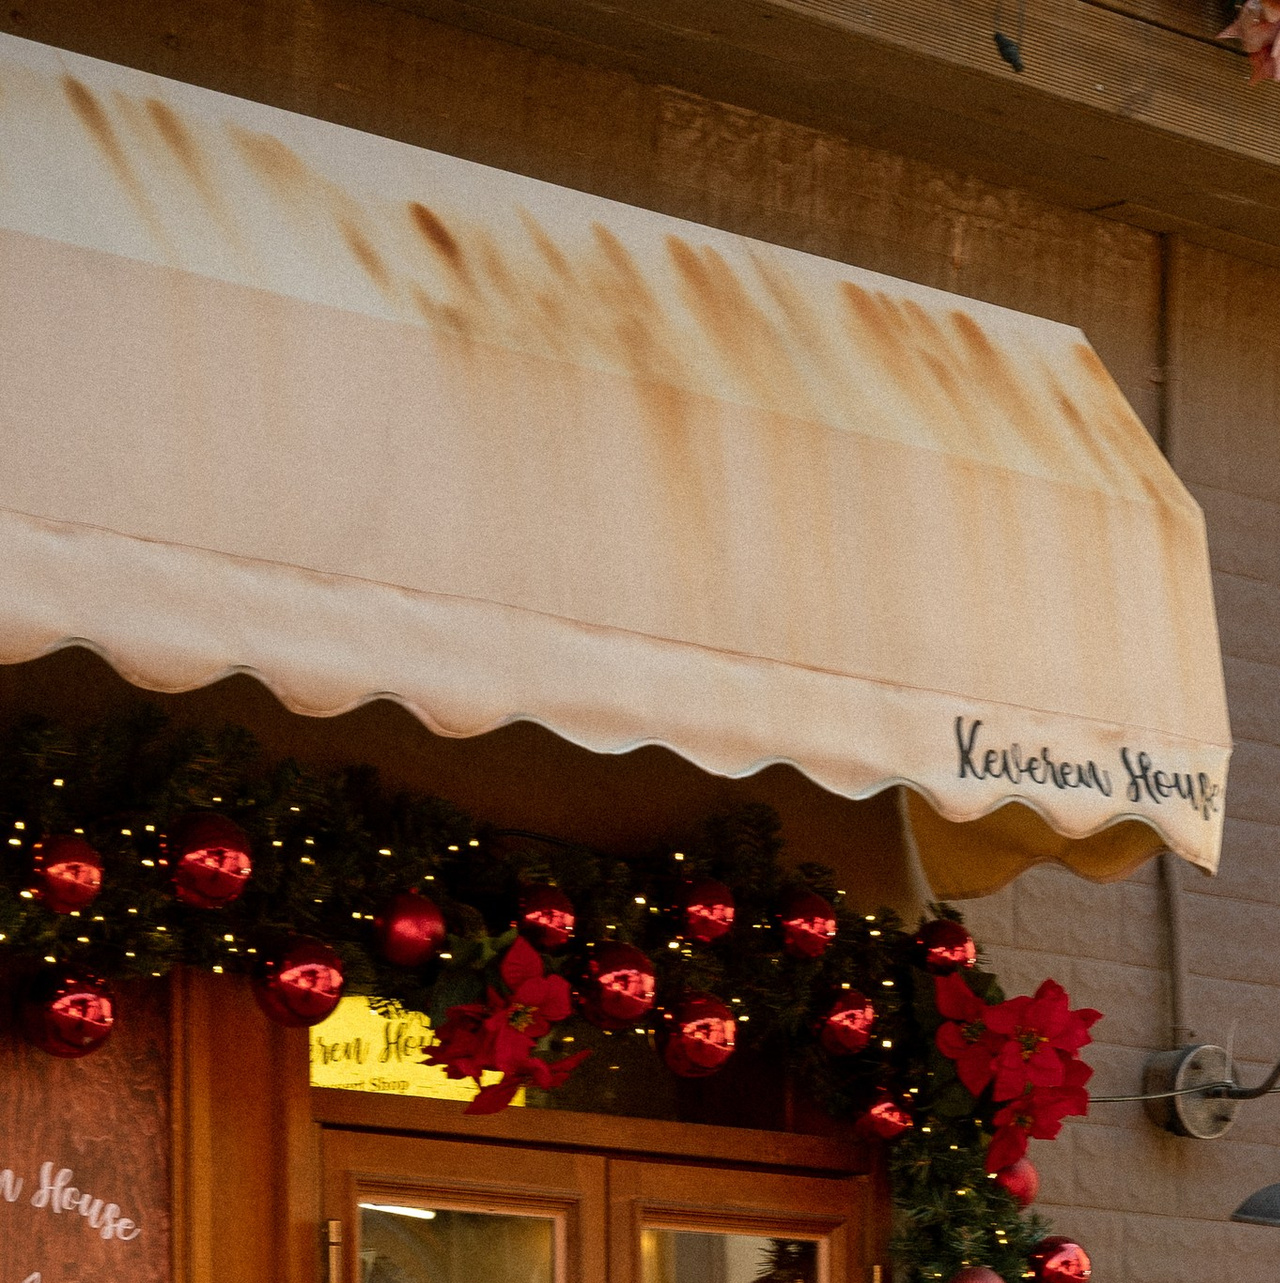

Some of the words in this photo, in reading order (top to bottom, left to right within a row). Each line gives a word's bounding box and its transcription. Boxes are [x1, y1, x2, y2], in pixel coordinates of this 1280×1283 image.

[954, 715, 1112, 798] Keveren
[1120, 746, 1220, 821] House
[30, 1161, 141, 1241] House
